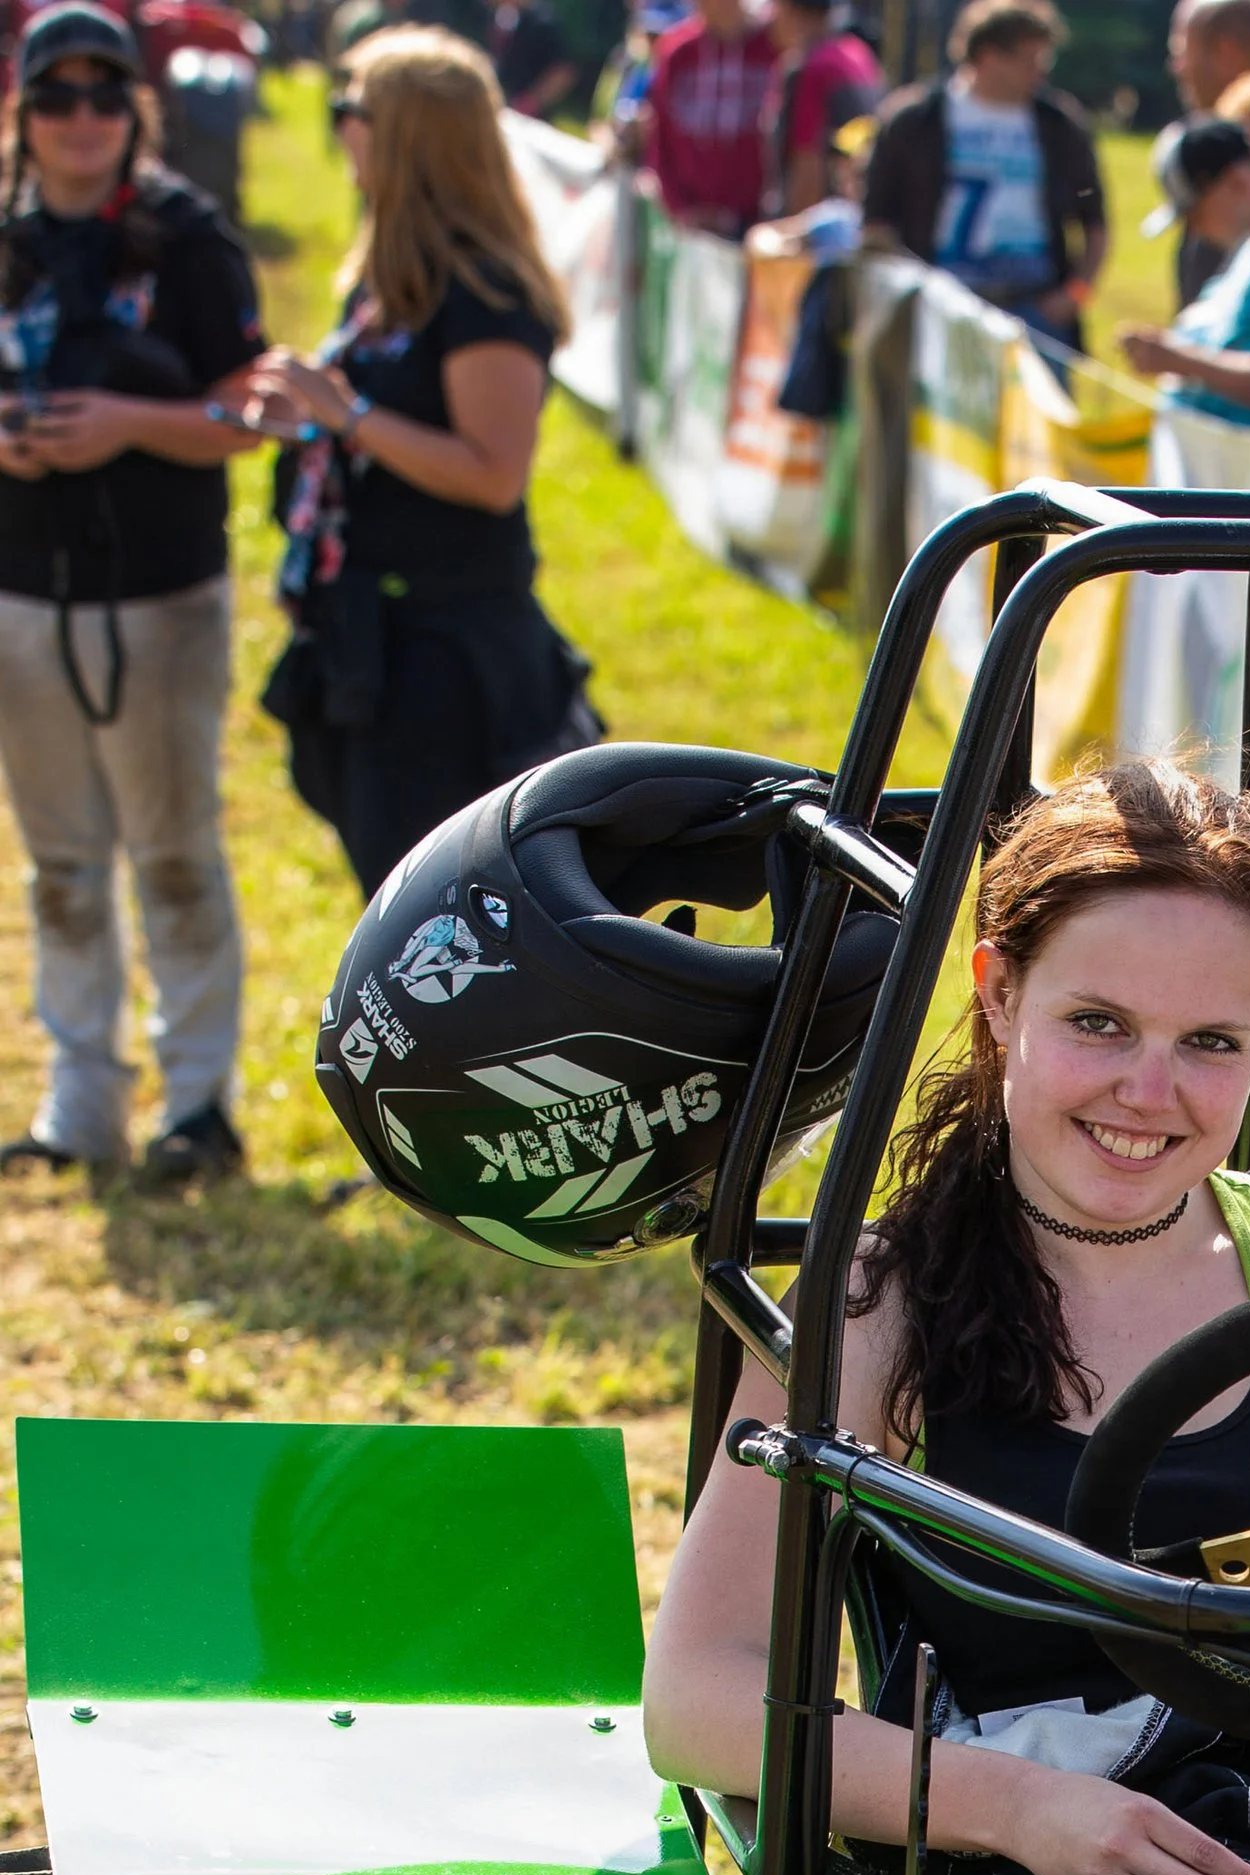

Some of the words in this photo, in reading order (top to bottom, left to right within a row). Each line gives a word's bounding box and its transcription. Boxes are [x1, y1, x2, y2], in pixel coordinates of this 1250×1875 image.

[356, 980, 408, 1061] SHARK
[366, 971, 393, 1018] LEGION
[464, 1072, 722, 1183] SHARK
[532, 1084, 631, 1125] LEGION
